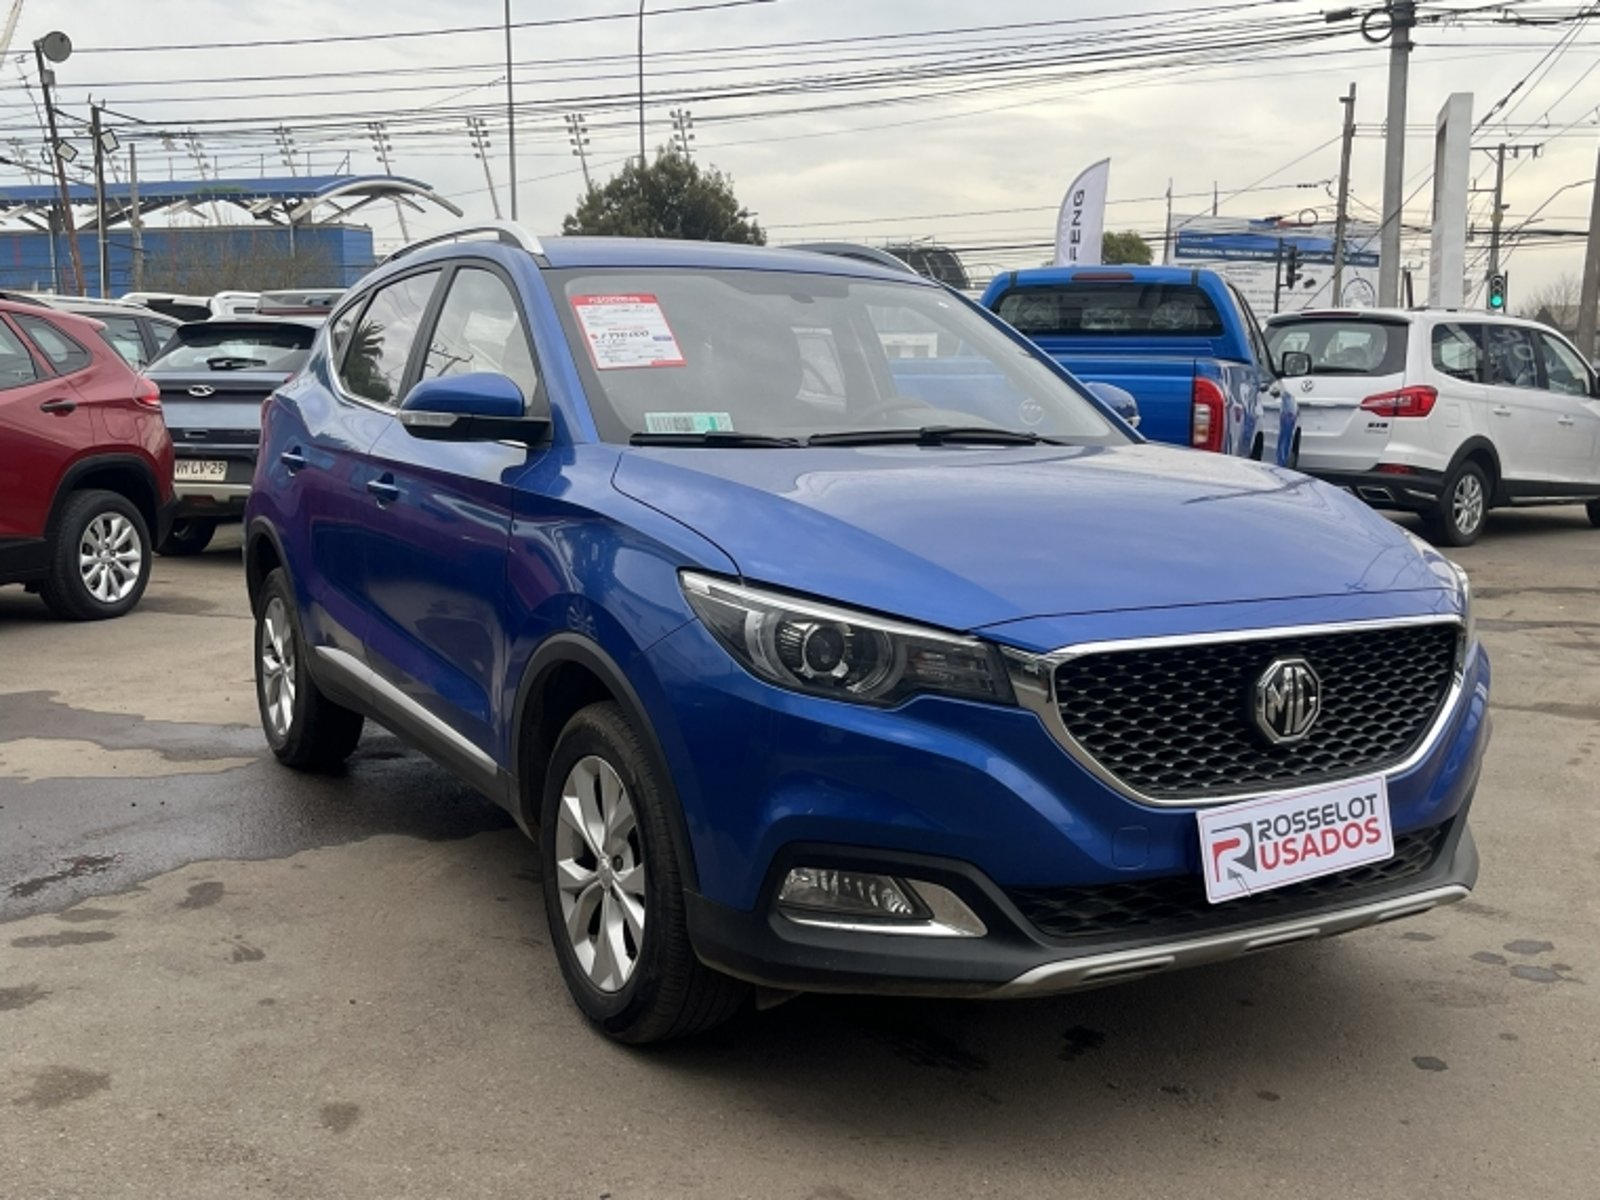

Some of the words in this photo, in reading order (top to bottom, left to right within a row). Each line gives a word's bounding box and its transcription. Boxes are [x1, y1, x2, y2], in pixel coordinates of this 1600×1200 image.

[1267, 666, 1317, 735] MG
[1257, 794, 1377, 842] ROSSELOT
[1260, 817, 1382, 870] USADOS
